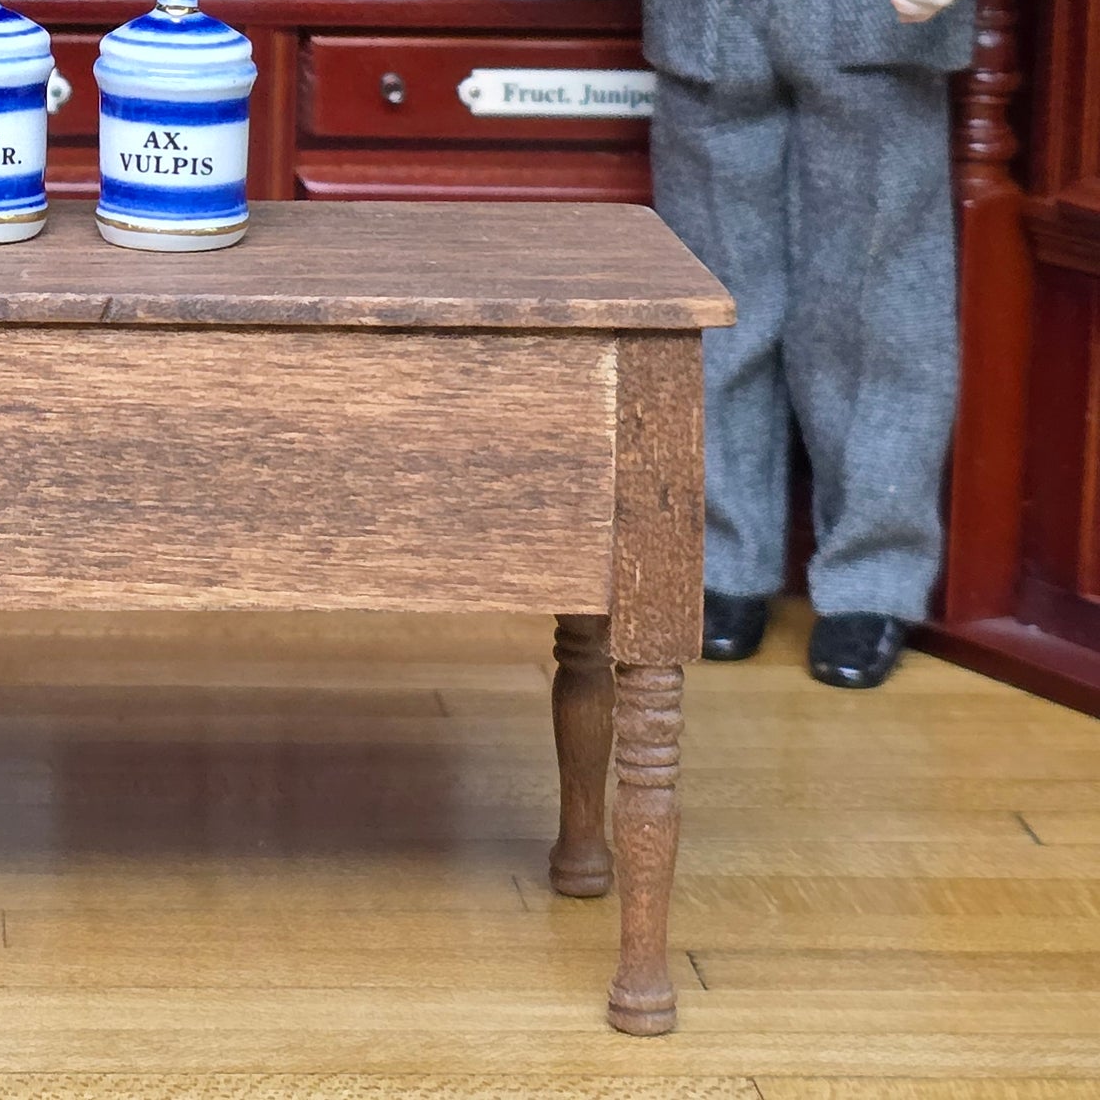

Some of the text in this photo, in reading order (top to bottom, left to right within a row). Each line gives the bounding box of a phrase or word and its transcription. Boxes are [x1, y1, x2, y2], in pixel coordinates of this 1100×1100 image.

[502, 82, 571, 105] Fruct.
[142, 130, 189, 151] AX.
[119, 152, 214, 176] VULPIS
